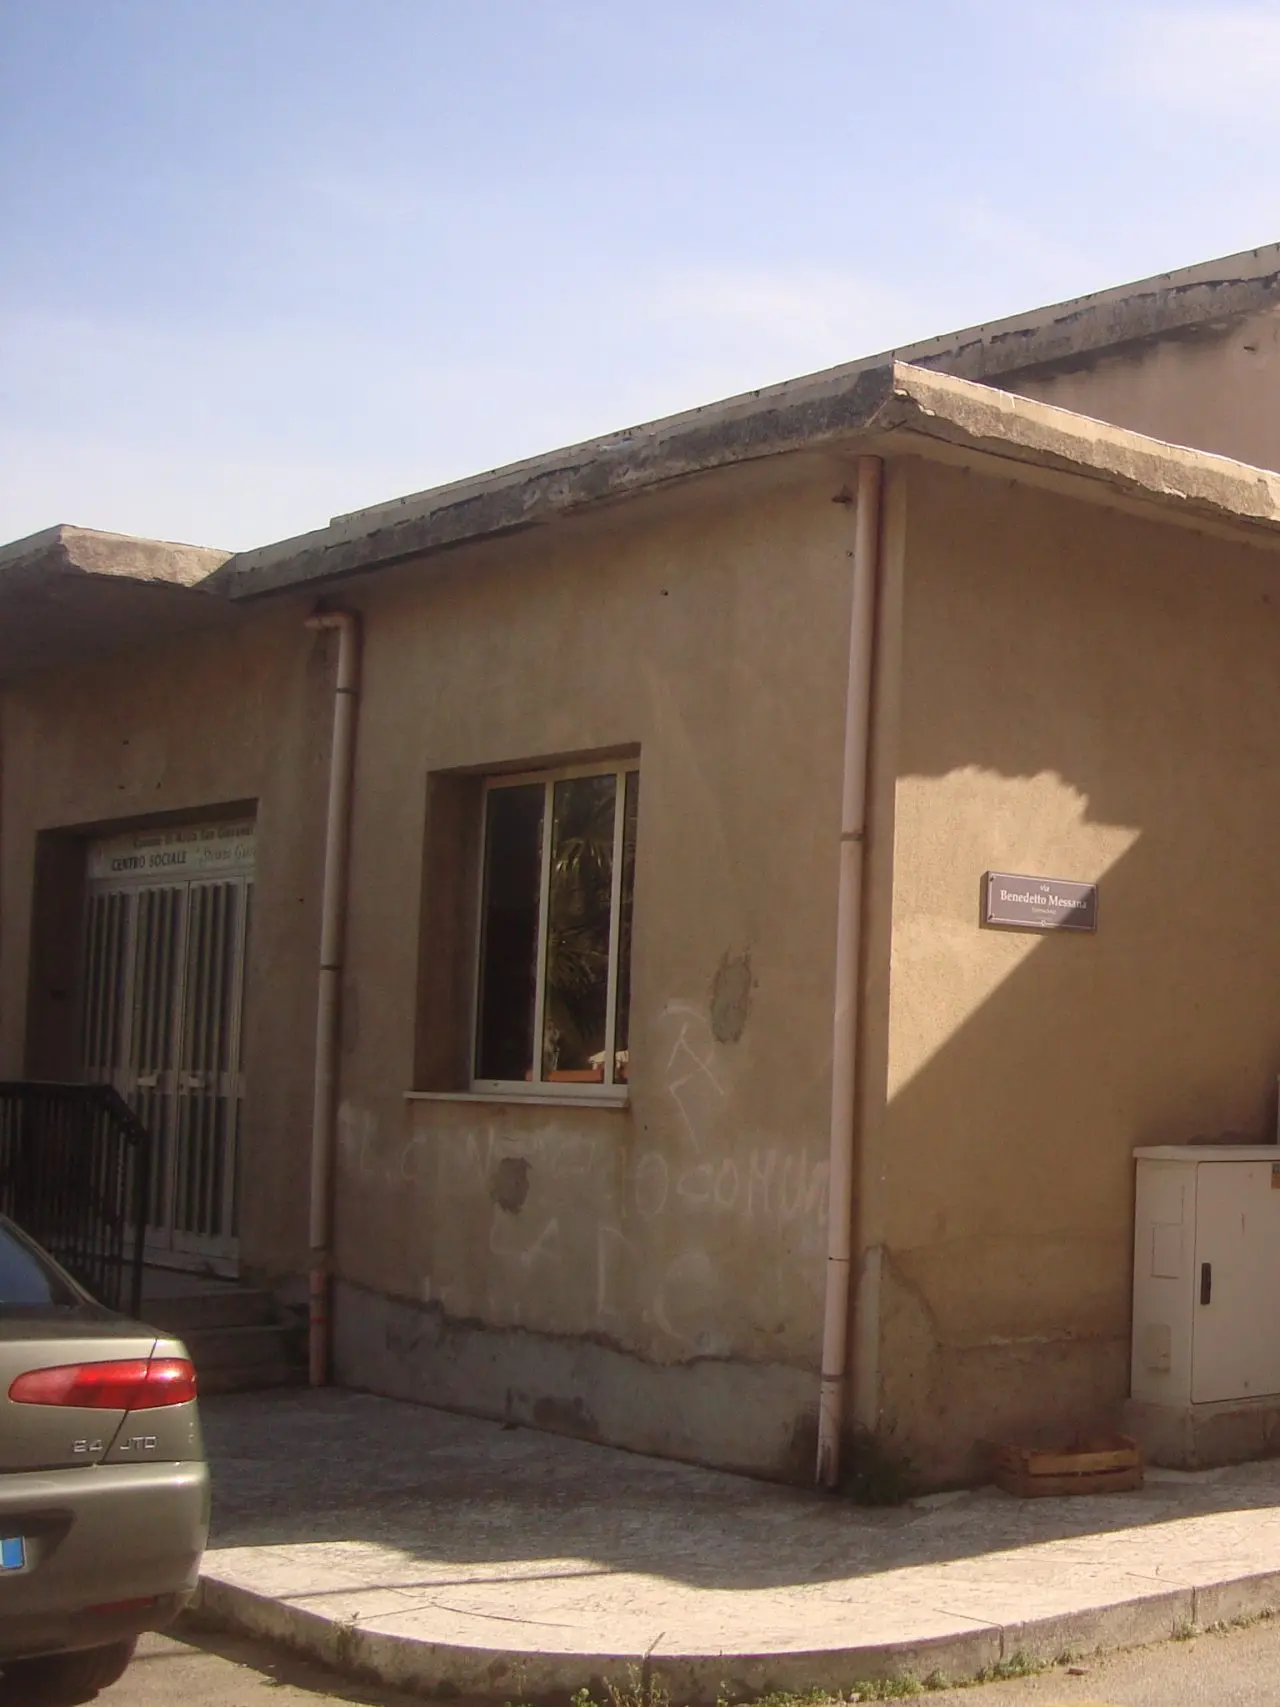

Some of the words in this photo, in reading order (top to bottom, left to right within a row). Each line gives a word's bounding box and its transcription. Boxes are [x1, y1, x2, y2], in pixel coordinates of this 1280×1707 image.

[112, 855, 146, 872] CENTRO
[149, 850, 187, 868] SOCIALE
[1000, 889, 1047, 905] Benedetto
[1048, 895, 1087, 909] Messana
[120, 1436, 157, 1450] JTD
